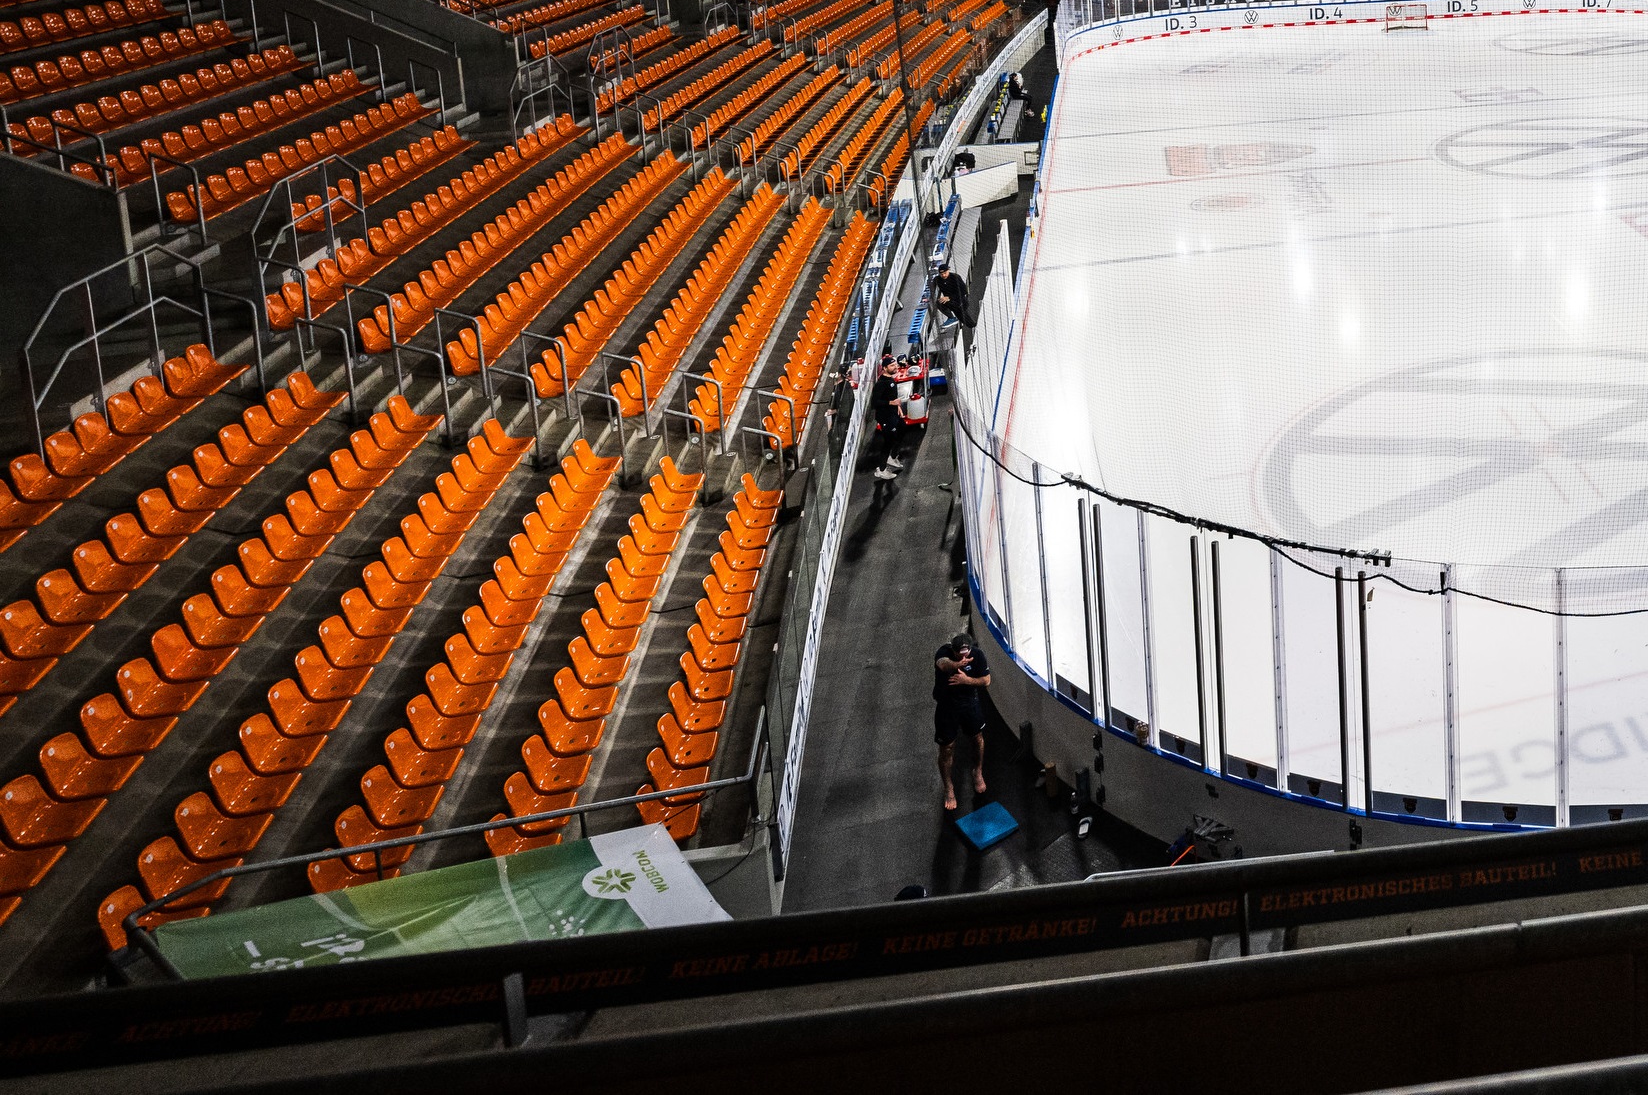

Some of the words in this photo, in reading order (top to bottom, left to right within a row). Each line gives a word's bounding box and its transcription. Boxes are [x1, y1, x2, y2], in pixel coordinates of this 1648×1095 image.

[1333, 6, 1343, 19] 4
[1470, 0, 1478, 12] 5
[1189, 16, 1198, 29] 3
[632, 850, 670, 894] WOBCOM
[1578, 848, 1643, 873] KEINE
[1259, 875, 1454, 914] ELEKTRONISCHES
[1459, 861, 1558, 889] BAUTEIL!
[1121, 898, 1239, 929] ACHTUNG!
[882, 929, 957, 955] KEINE
[670, 953, 750, 980] KEINE
[755, 942, 860, 972] ABLAGE!
